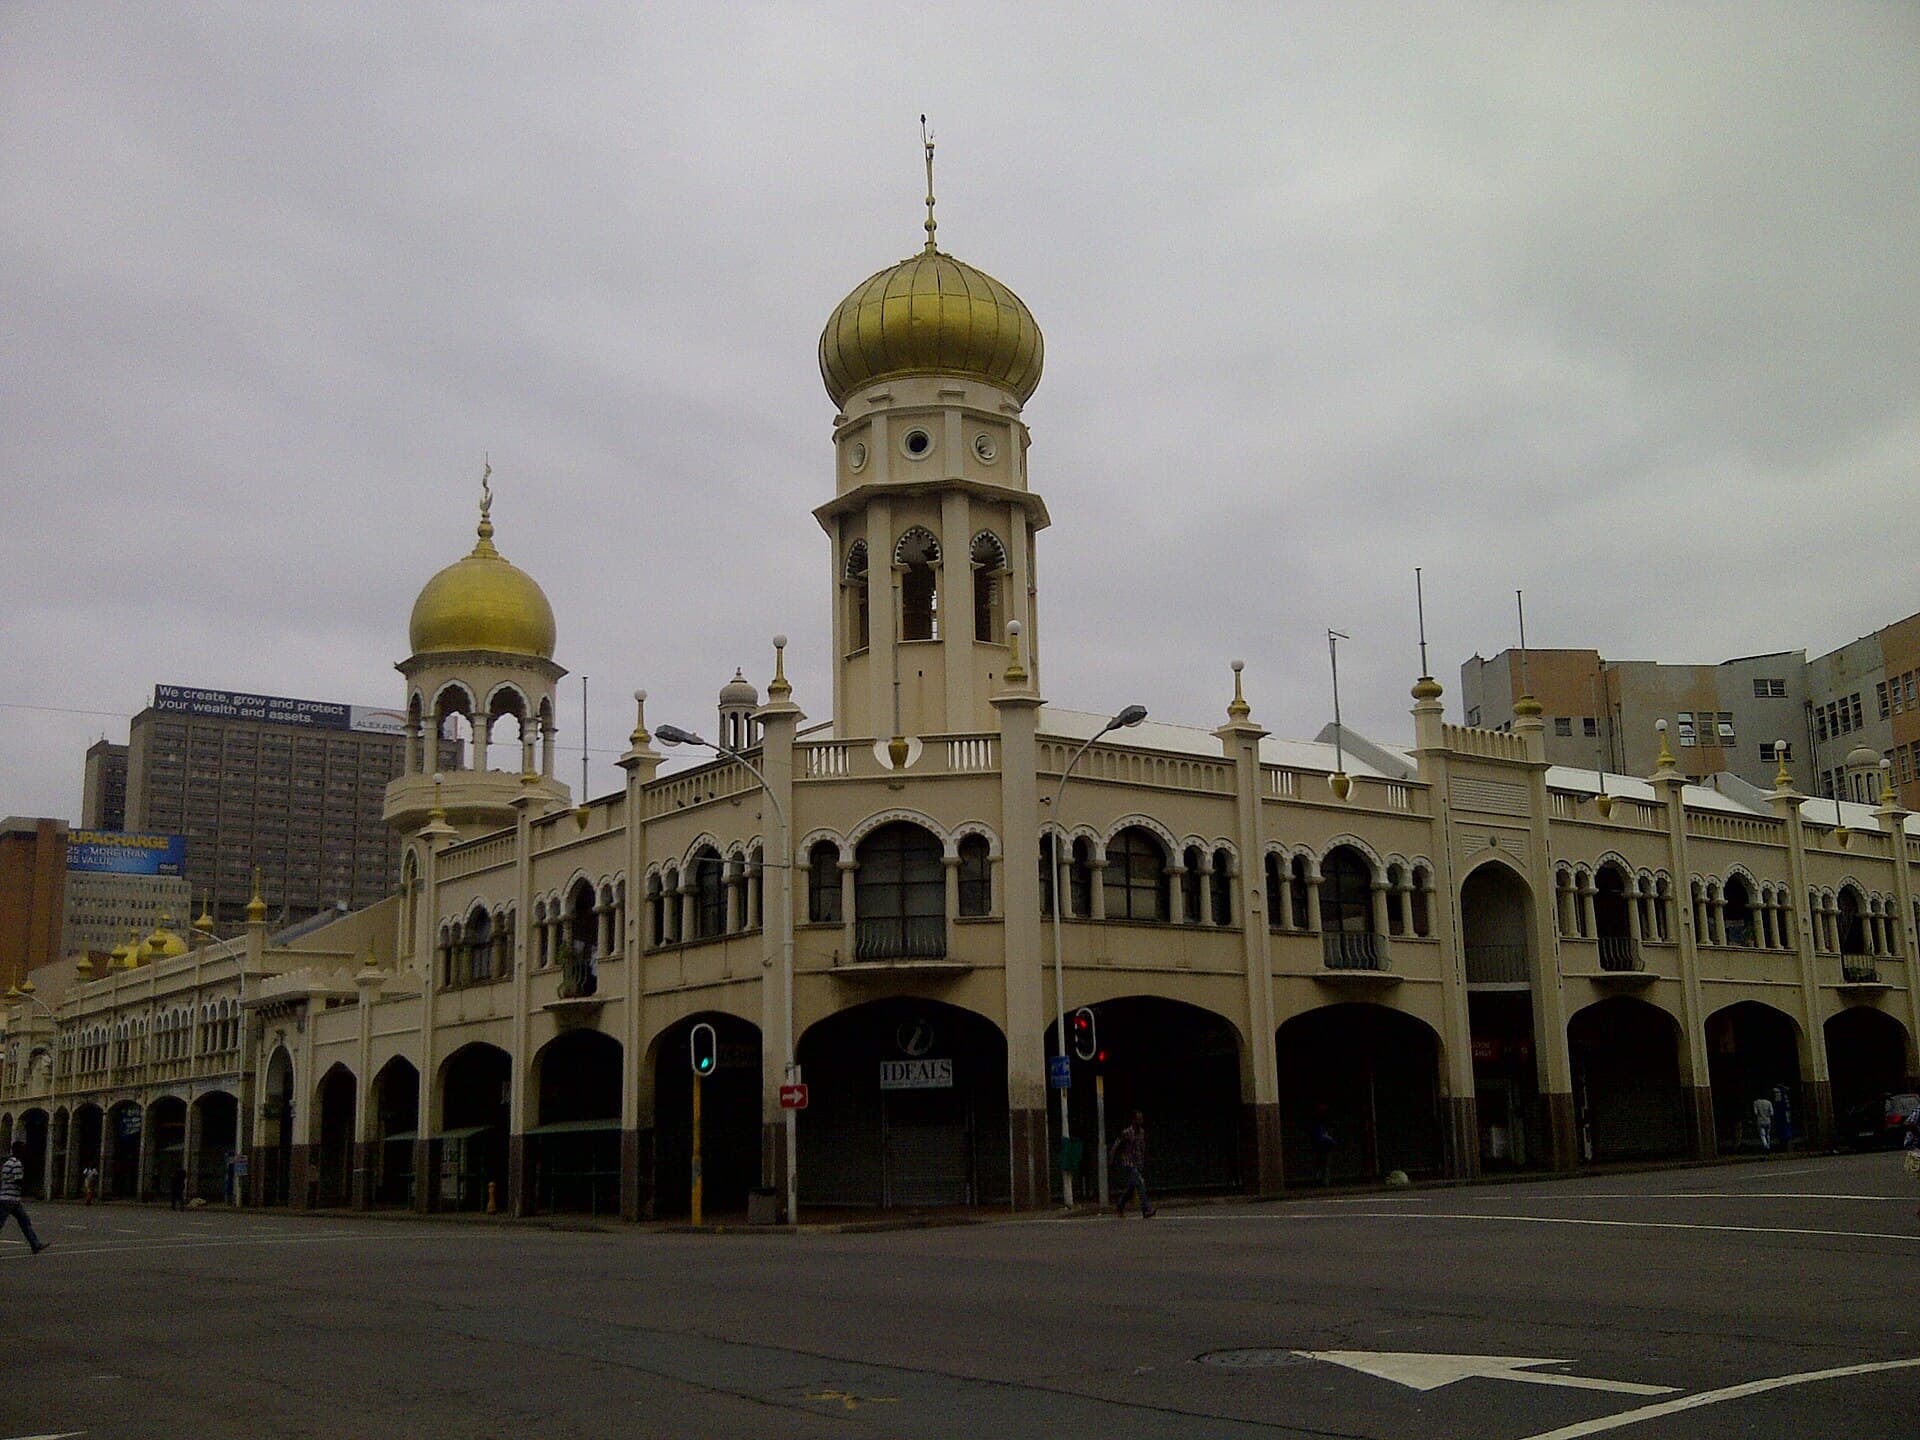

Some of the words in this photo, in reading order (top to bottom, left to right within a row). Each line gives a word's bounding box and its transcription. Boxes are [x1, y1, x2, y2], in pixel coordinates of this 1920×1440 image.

[159, 686, 179, 697] We
[183, 689, 229, 703] create,
[233, 695, 266, 706] grow
[269, 698, 293, 709] and
[297, 702, 345, 715] protect
[159, 700, 188, 710] your
[193, 702, 237, 715] wealth
[241, 706, 265, 718] and
[268, 710, 314, 723] assets.
[90, 847, 120, 858] MORE
[120, 848, 148, 859] THAN
[883, 1062, 951, 1081] IDEALS
